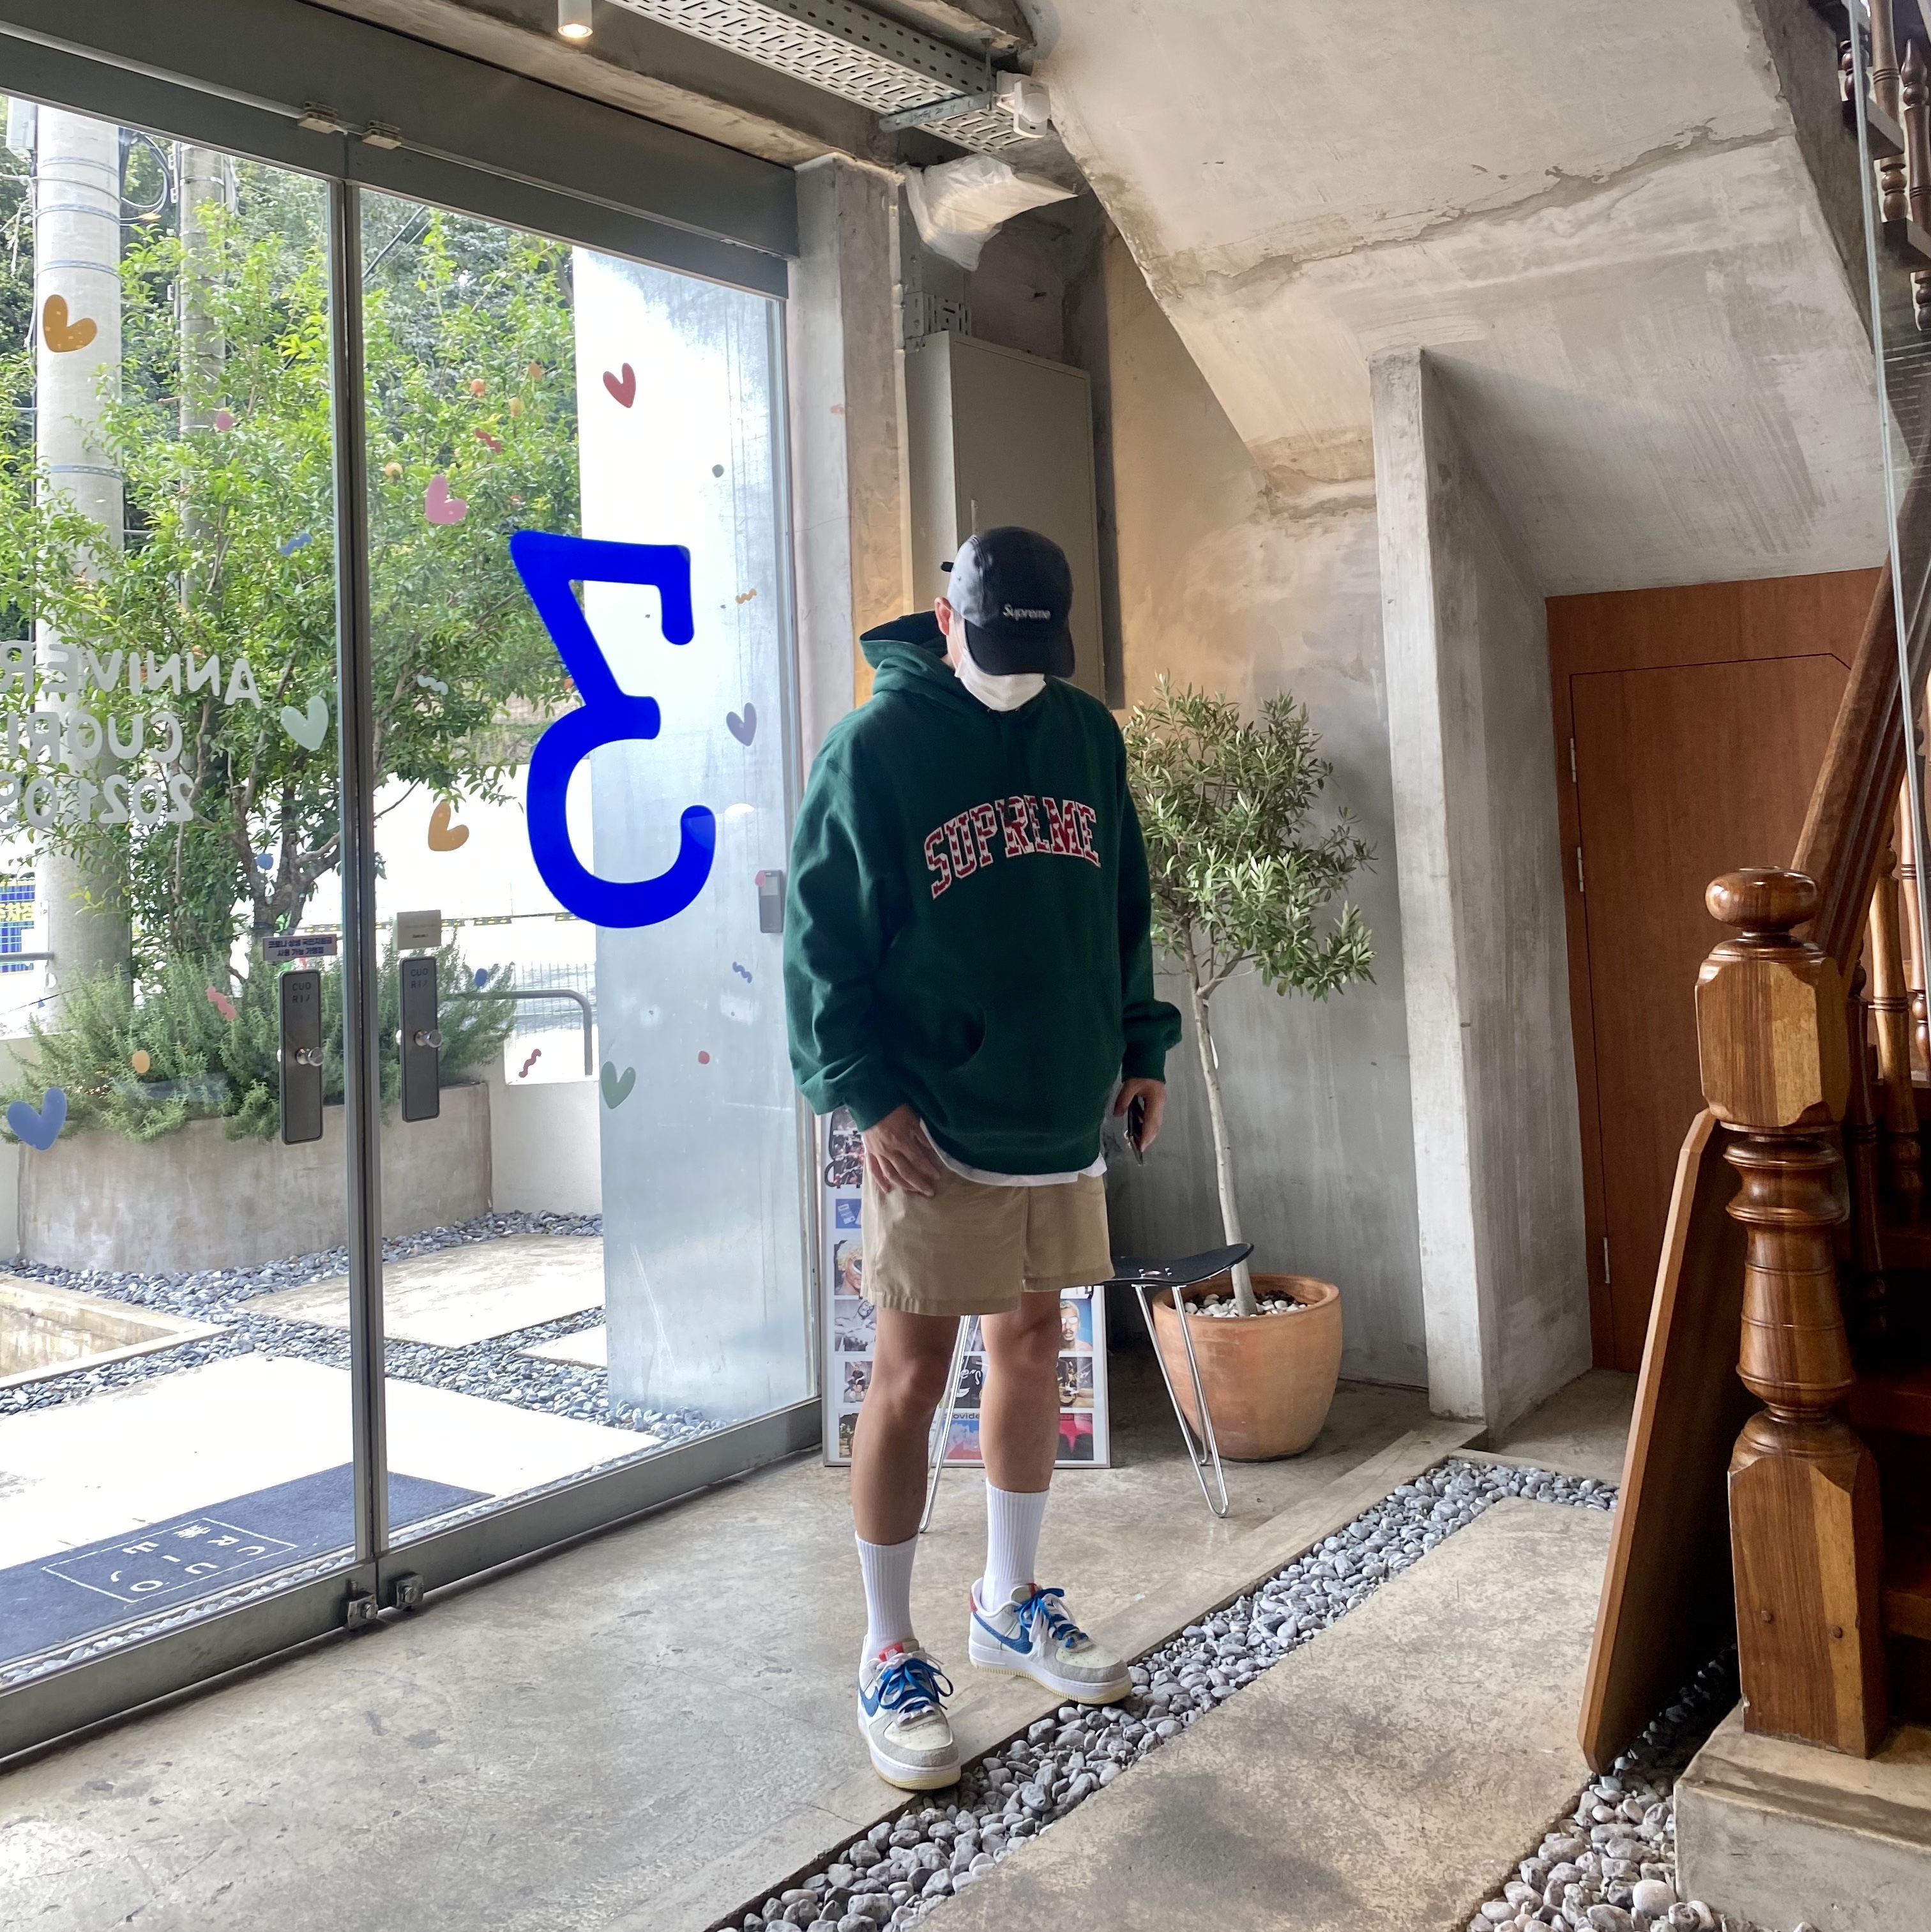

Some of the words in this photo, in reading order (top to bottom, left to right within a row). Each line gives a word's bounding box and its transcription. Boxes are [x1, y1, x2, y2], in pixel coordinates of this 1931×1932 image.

[1003, 604, 1051, 621] Supreme
[924, 795, 1102, 901] SUPREME
[411, 968, 428, 977] CUO
[292, 982, 312, 991] CUO
